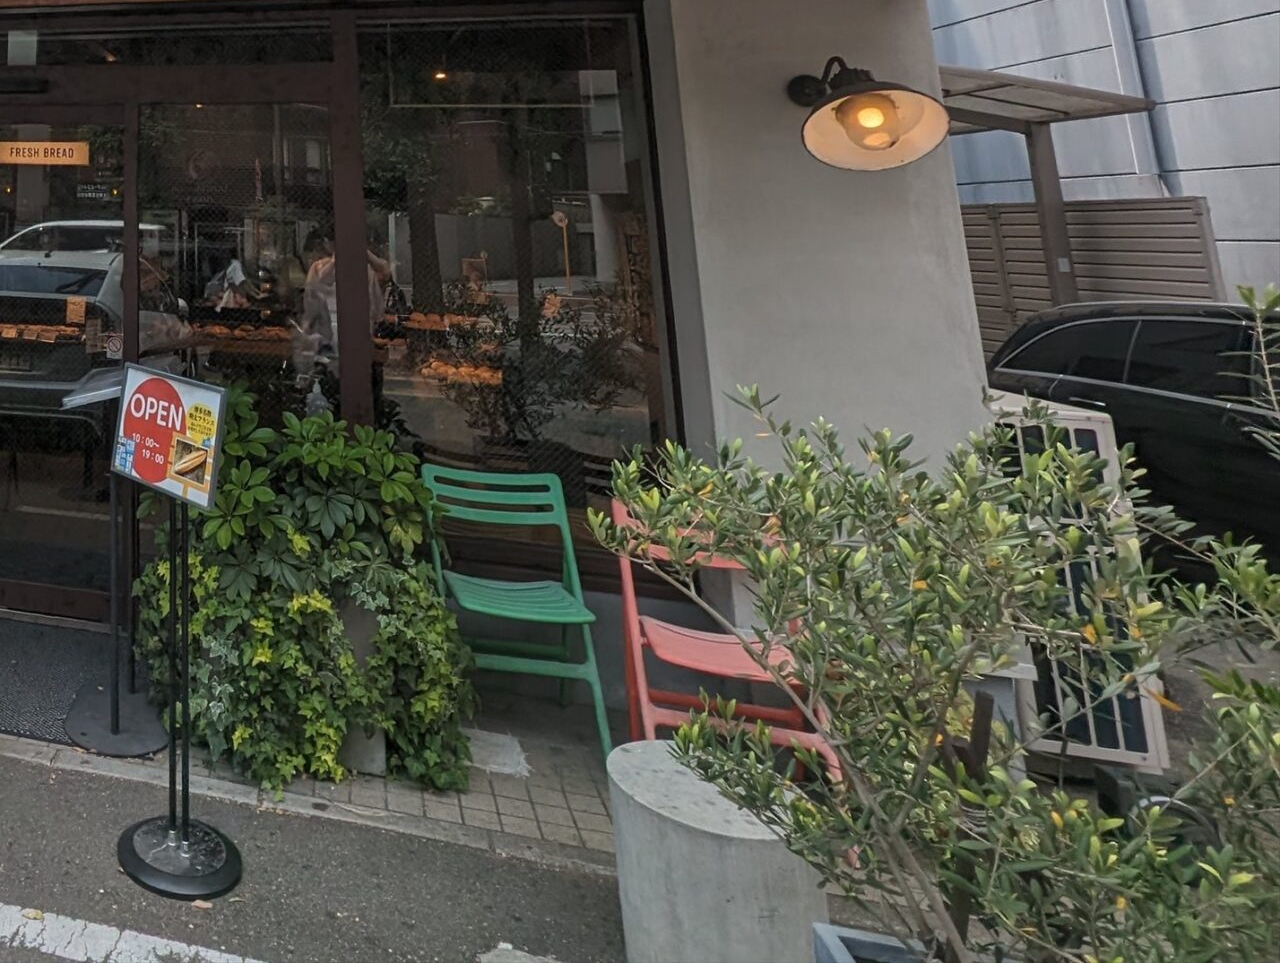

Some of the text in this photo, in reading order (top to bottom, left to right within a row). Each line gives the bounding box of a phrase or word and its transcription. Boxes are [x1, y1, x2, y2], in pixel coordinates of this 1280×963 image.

[10, 147, 74, 159] FRESH BREAD
[130, 393, 183, 431] OPEN
[142, 448, 164, 465] 19:00
